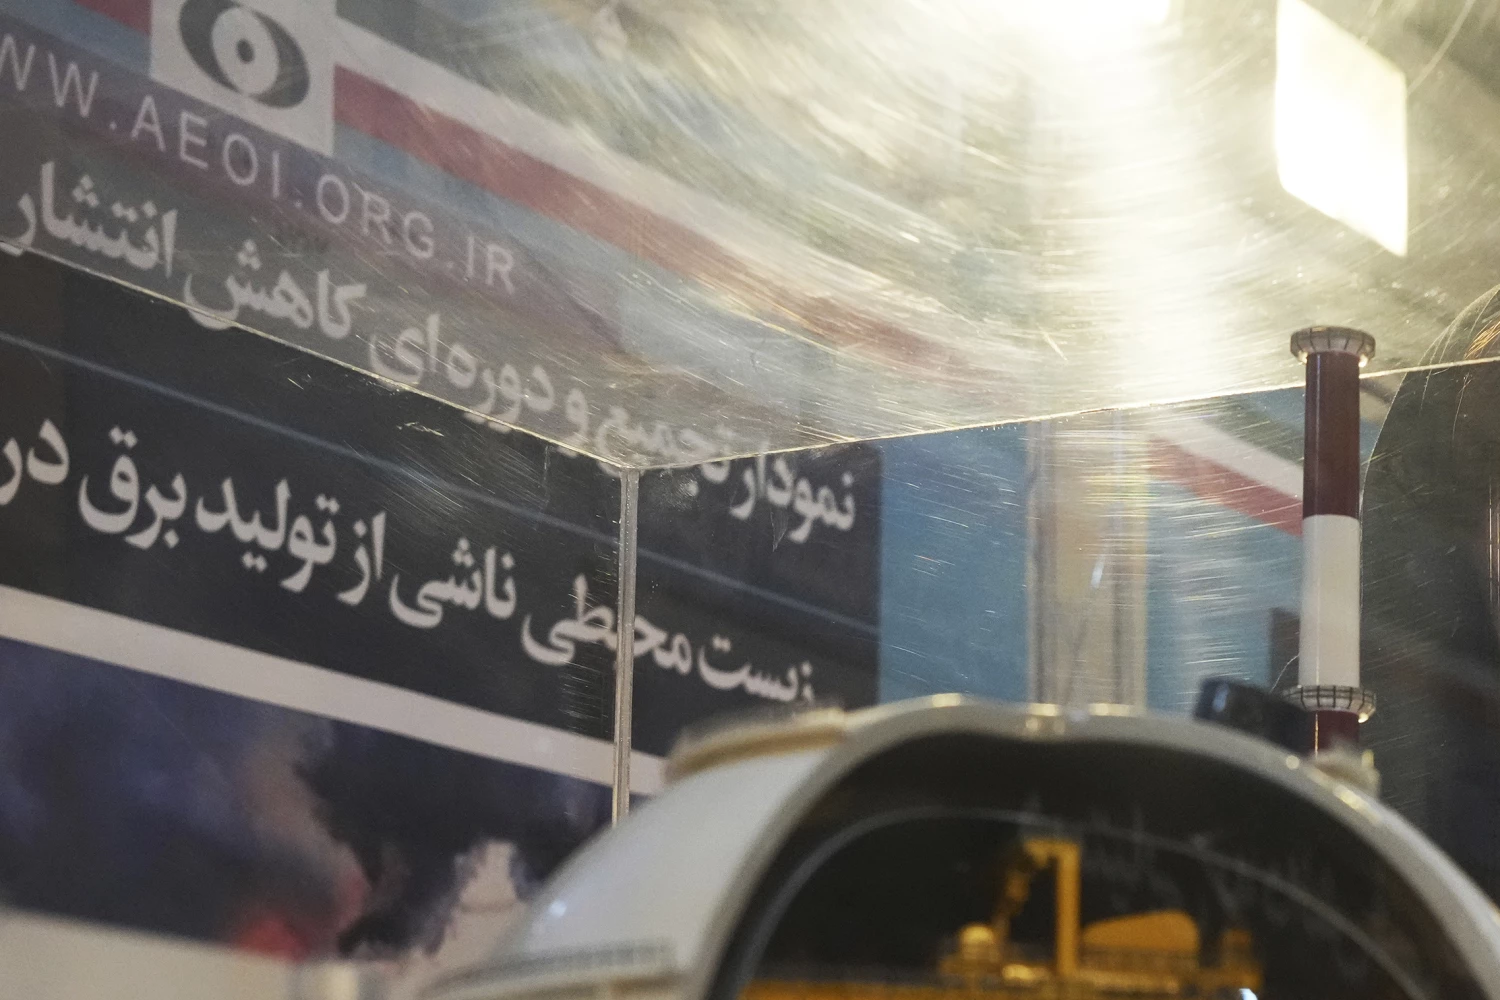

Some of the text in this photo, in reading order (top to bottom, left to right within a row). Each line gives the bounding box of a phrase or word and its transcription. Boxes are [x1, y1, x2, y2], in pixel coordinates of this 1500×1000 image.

[0, 160, 178, 278] انتشار
[184, 239, 367, 339] کاهش
[0, 418, 70, 506] در
[555, 388, 590, 456] و
[78, 424, 188, 549] برق
[196, 476, 340, 592] تولید
[729, 440, 856, 543] نمودار
[336, 511, 386, 606] از
[389, 537, 517, 629] ناشی
[520, 573, 693, 675] محطی
